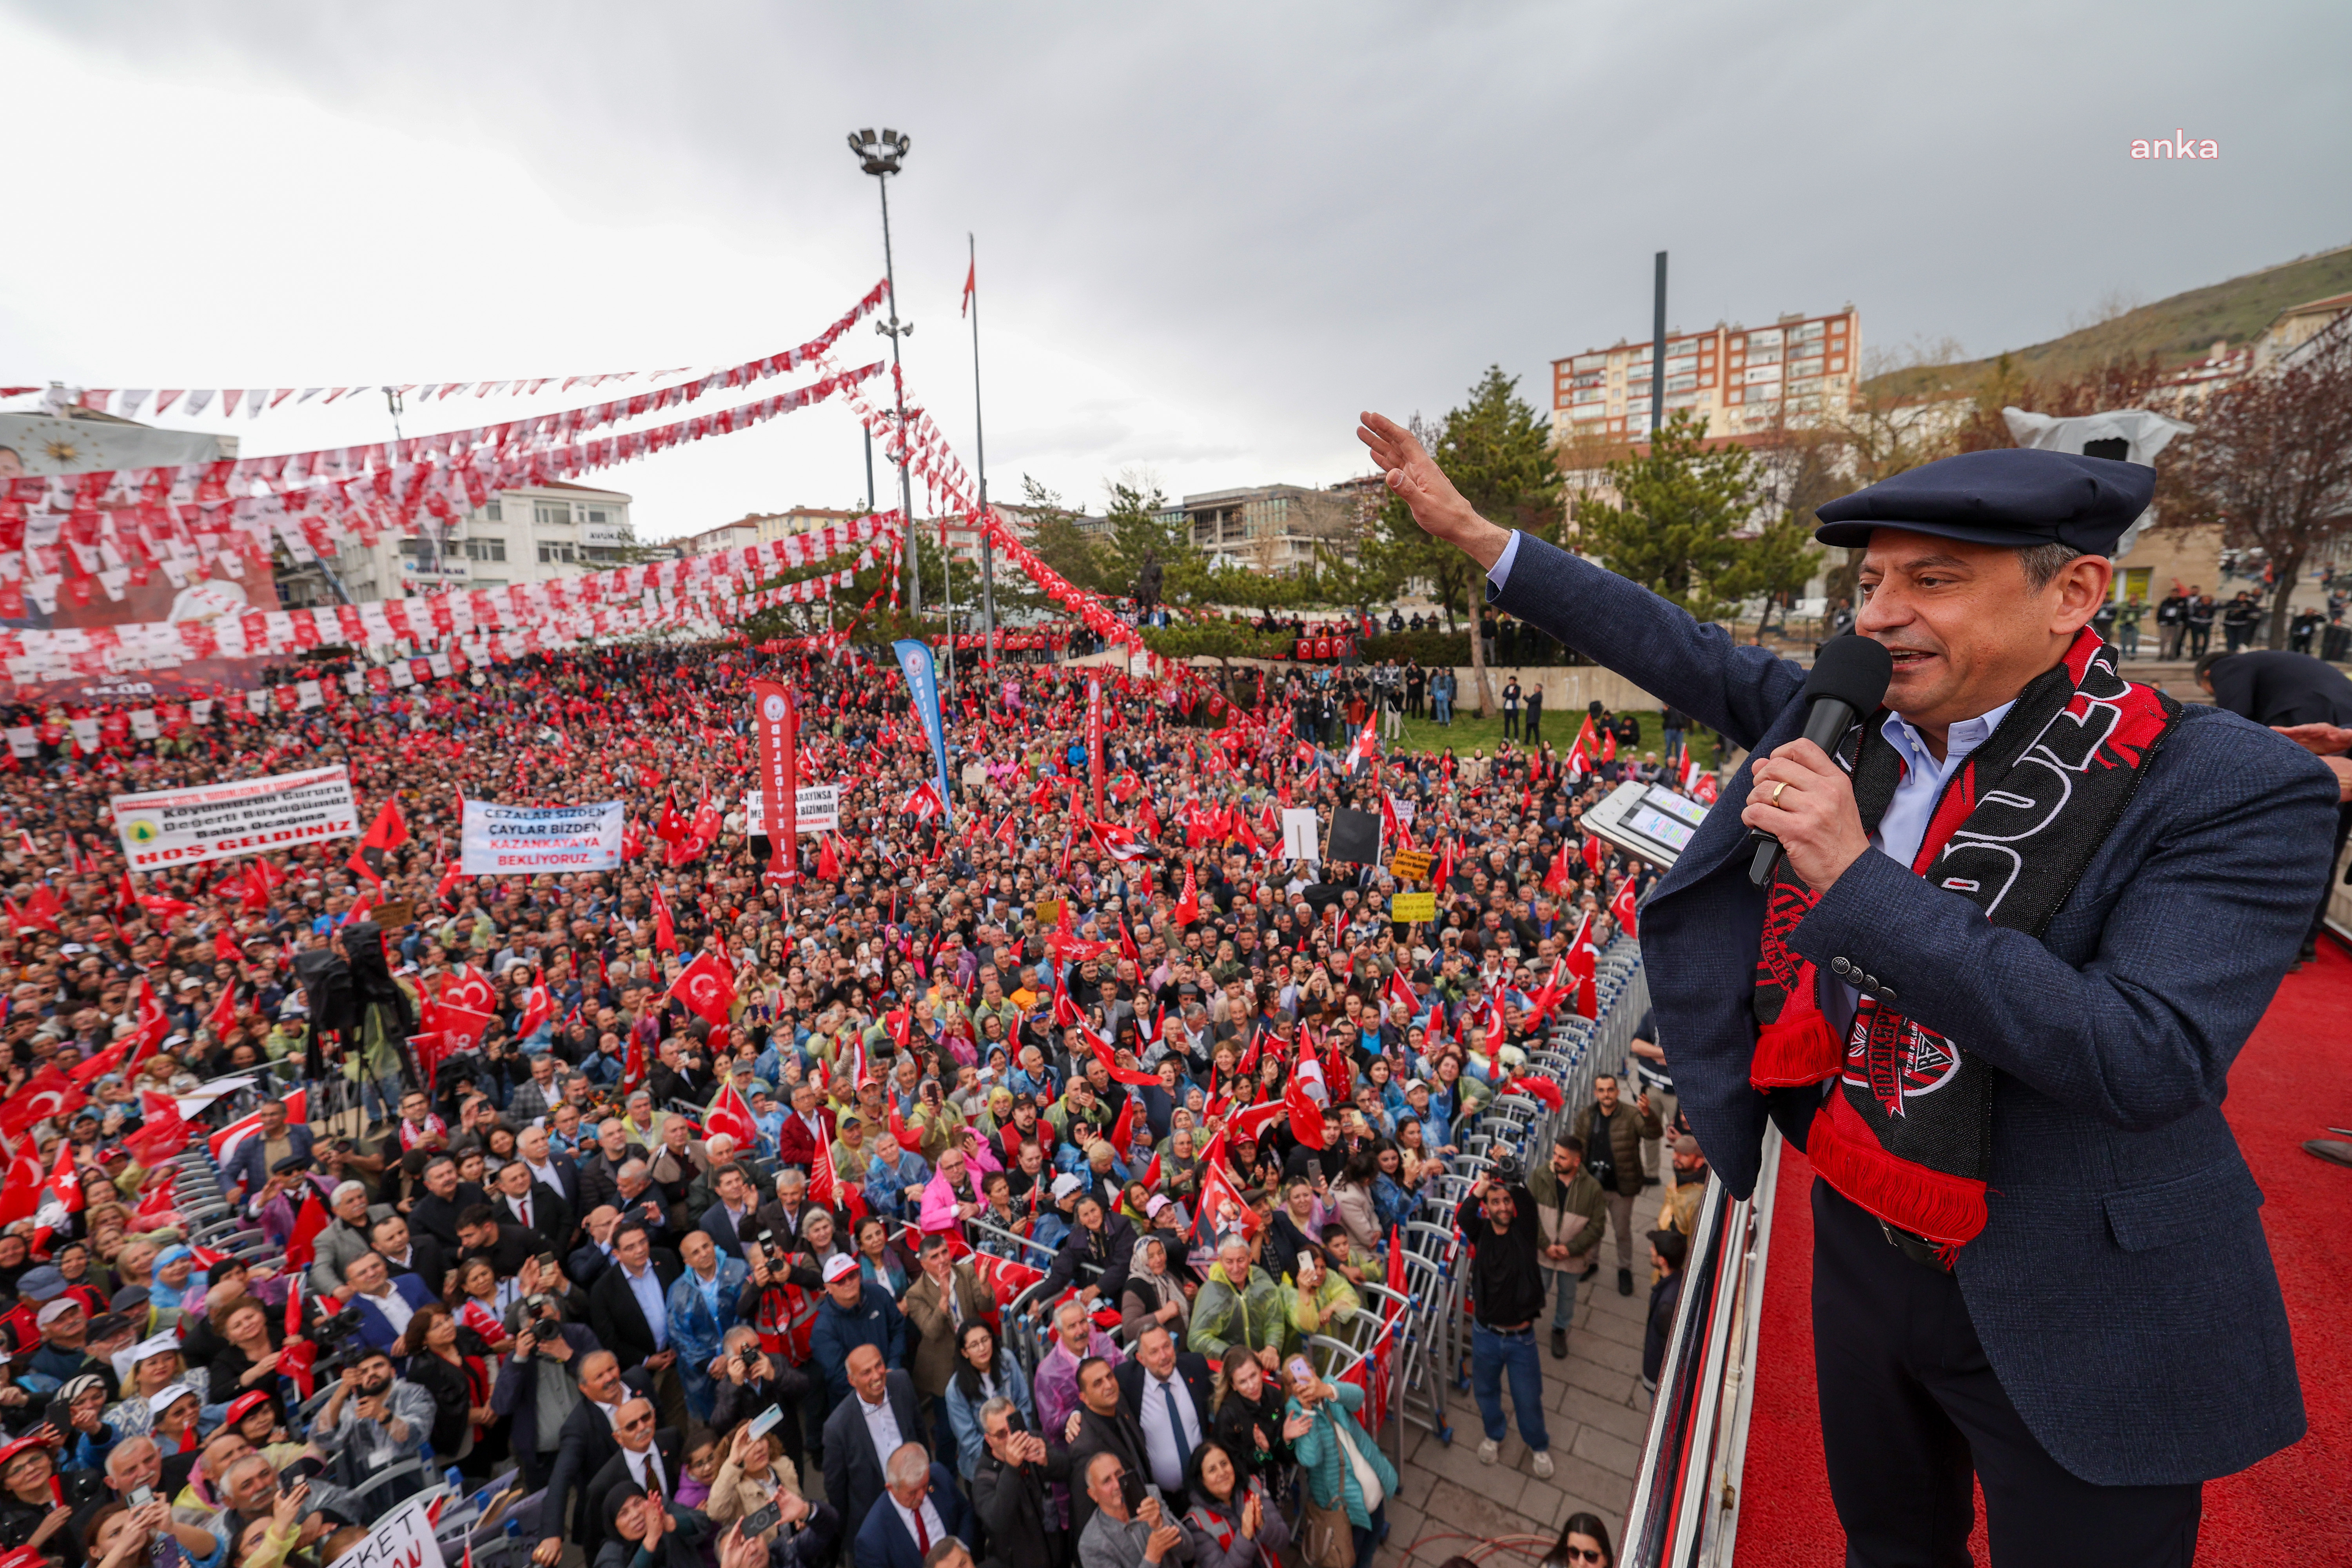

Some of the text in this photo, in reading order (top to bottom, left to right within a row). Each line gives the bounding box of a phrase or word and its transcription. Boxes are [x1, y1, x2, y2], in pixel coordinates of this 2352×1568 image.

[485, 809, 552, 820] CEZALAR
[196, 824, 245, 838] Baba
[489, 822, 601, 835] ÇAYLAR BİZDEN
[135, 820, 351, 864] HOŞ GELDİNİZ
[490, 837, 599, 849] KAZANKAYA'YA
